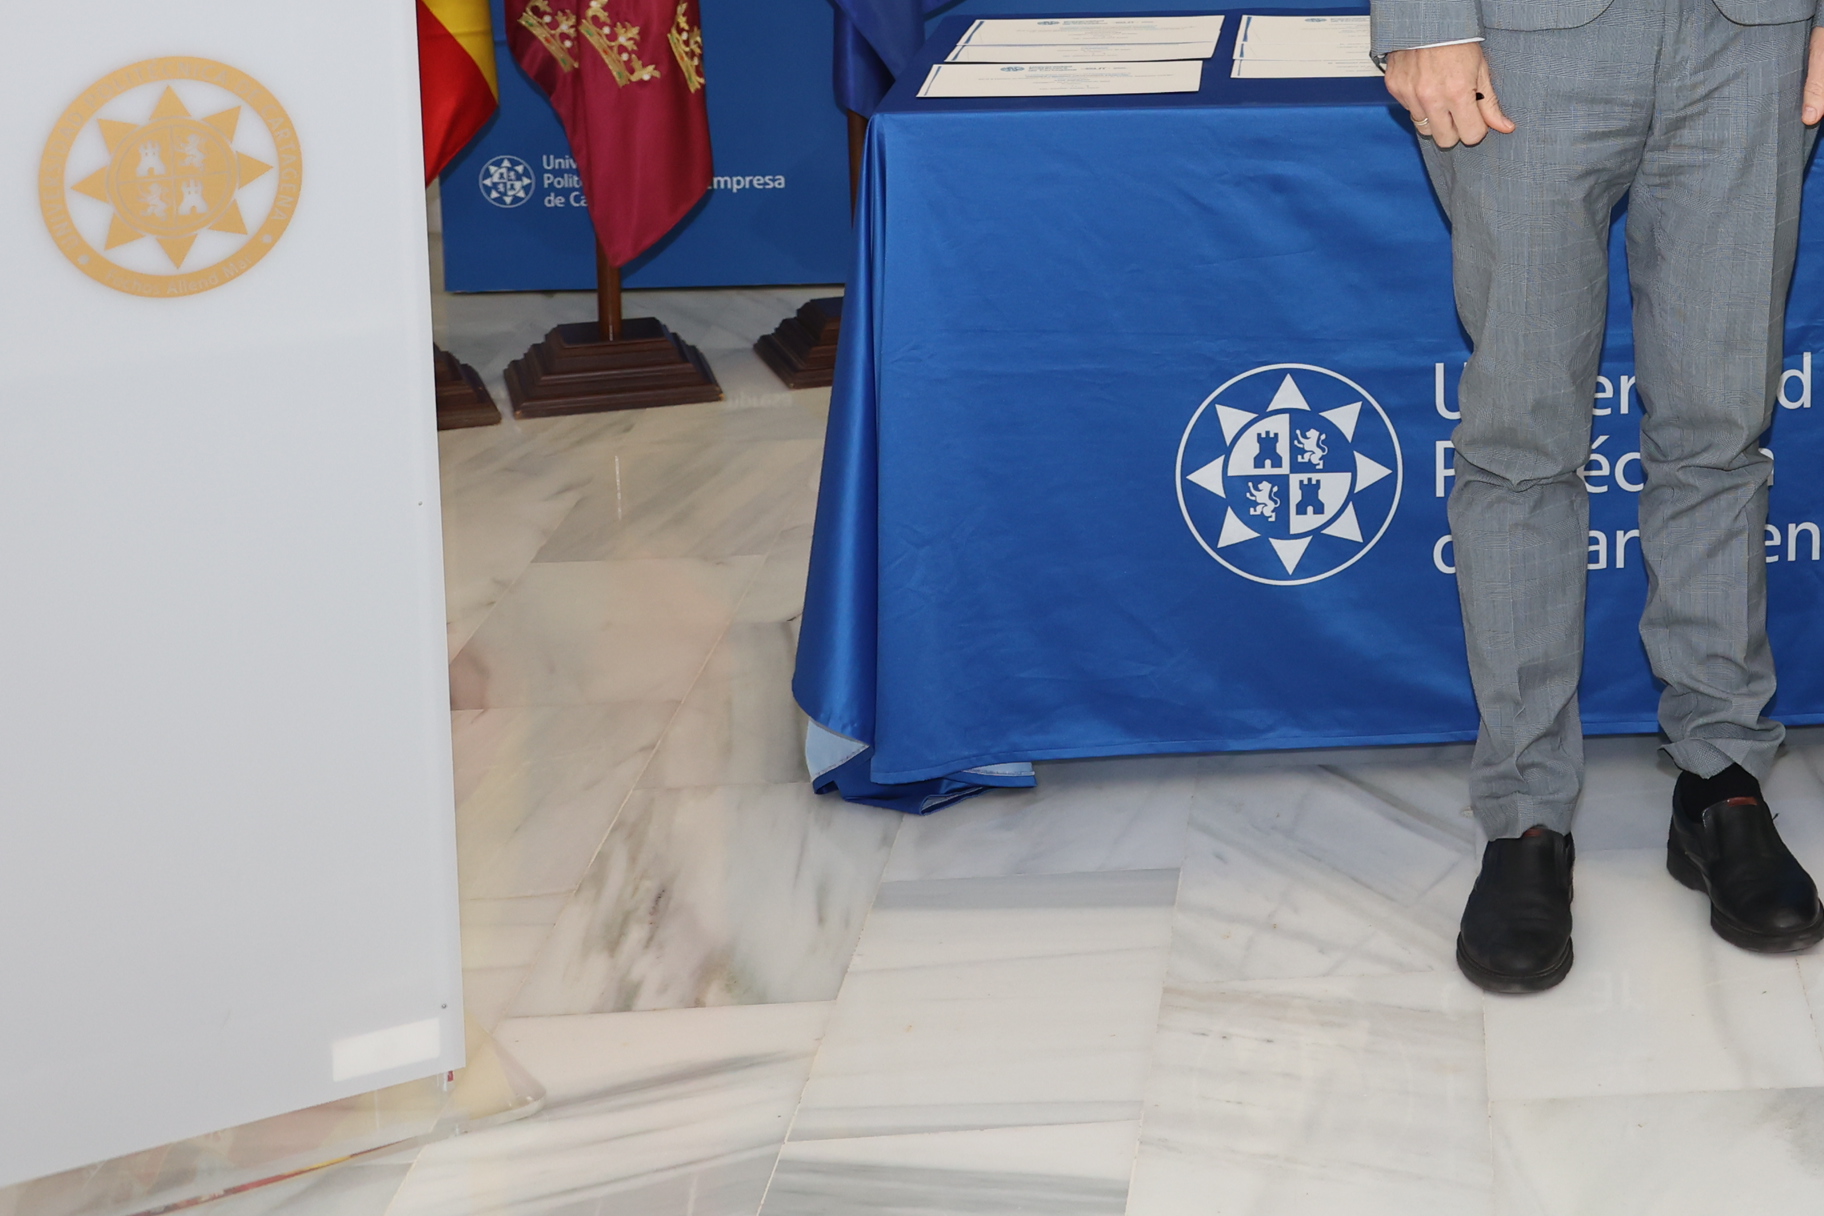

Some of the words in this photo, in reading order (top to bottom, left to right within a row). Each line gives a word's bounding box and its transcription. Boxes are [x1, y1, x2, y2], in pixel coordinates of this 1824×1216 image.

[43, 111, 86, 256] UNIVERSIDAD
[260, 103, 299, 222] CARTAGENA
[707, 174, 786, 193] mpresa
[544, 192, 566, 207] de
